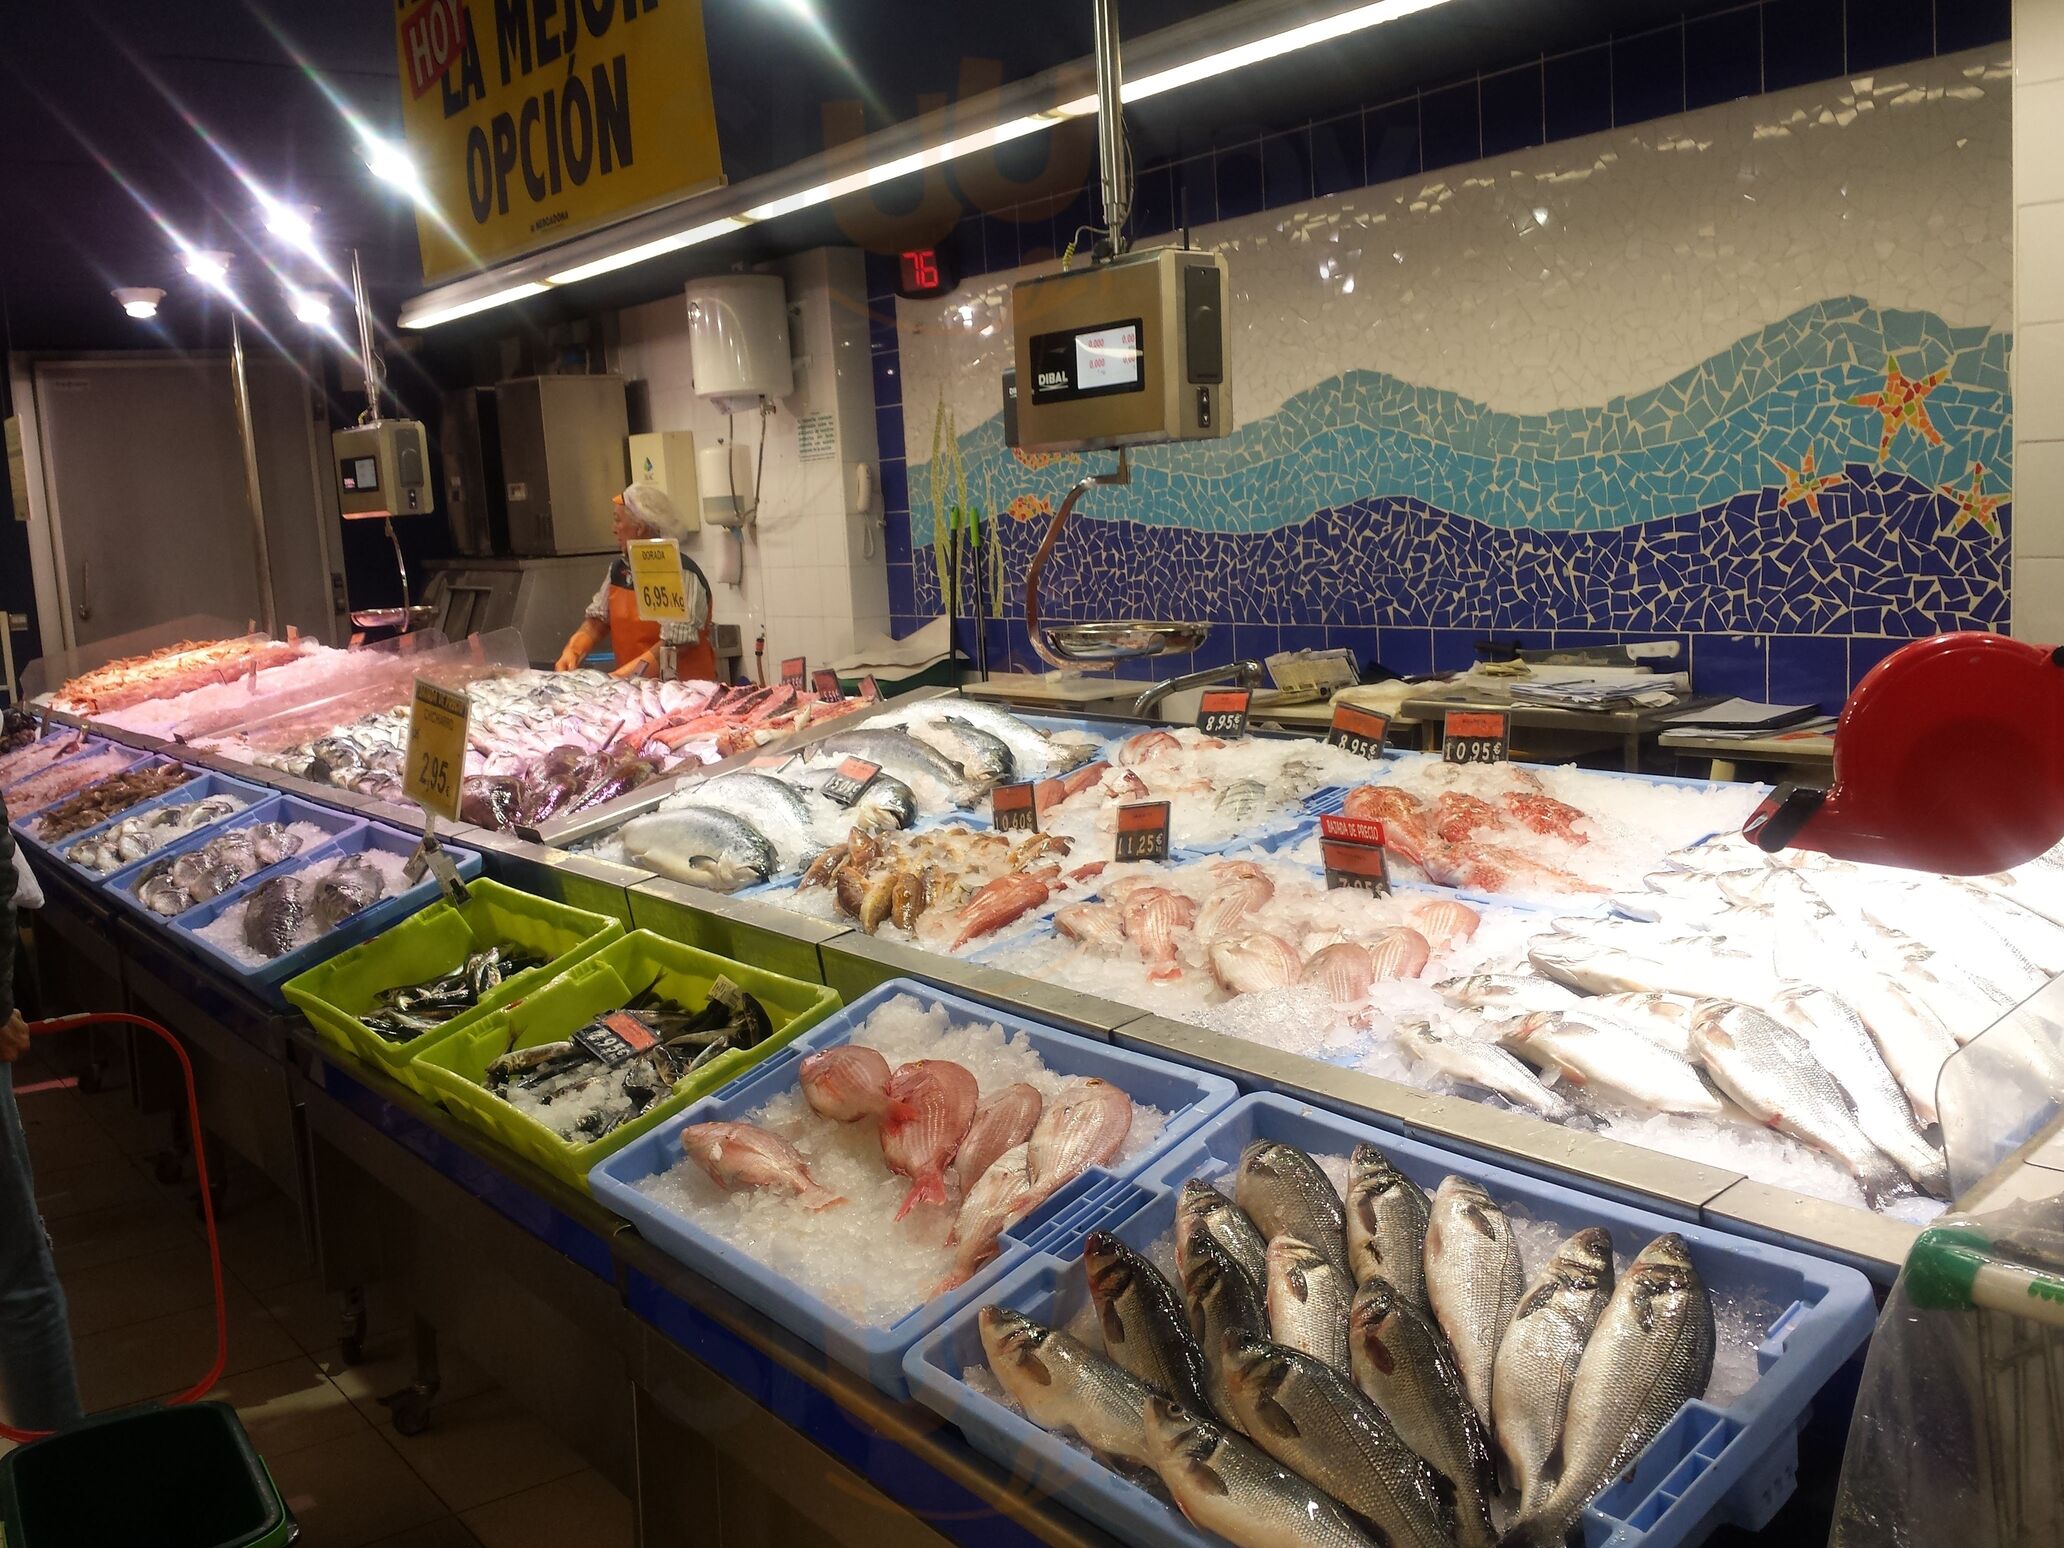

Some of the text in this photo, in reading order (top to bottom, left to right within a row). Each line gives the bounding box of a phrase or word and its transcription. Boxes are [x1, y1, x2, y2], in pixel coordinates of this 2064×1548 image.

[441, 0, 658, 120] LA MEJ
[466, 54, 634, 225] OPCIÓN
[903, 251, 939, 288] 76
[1038, 370, 1069, 386] DIBAL
[1338, 734, 1378, 758] 895€
[995, 810, 1032, 831] 1060€
[1357, 824, 1379, 841] PRECIO
